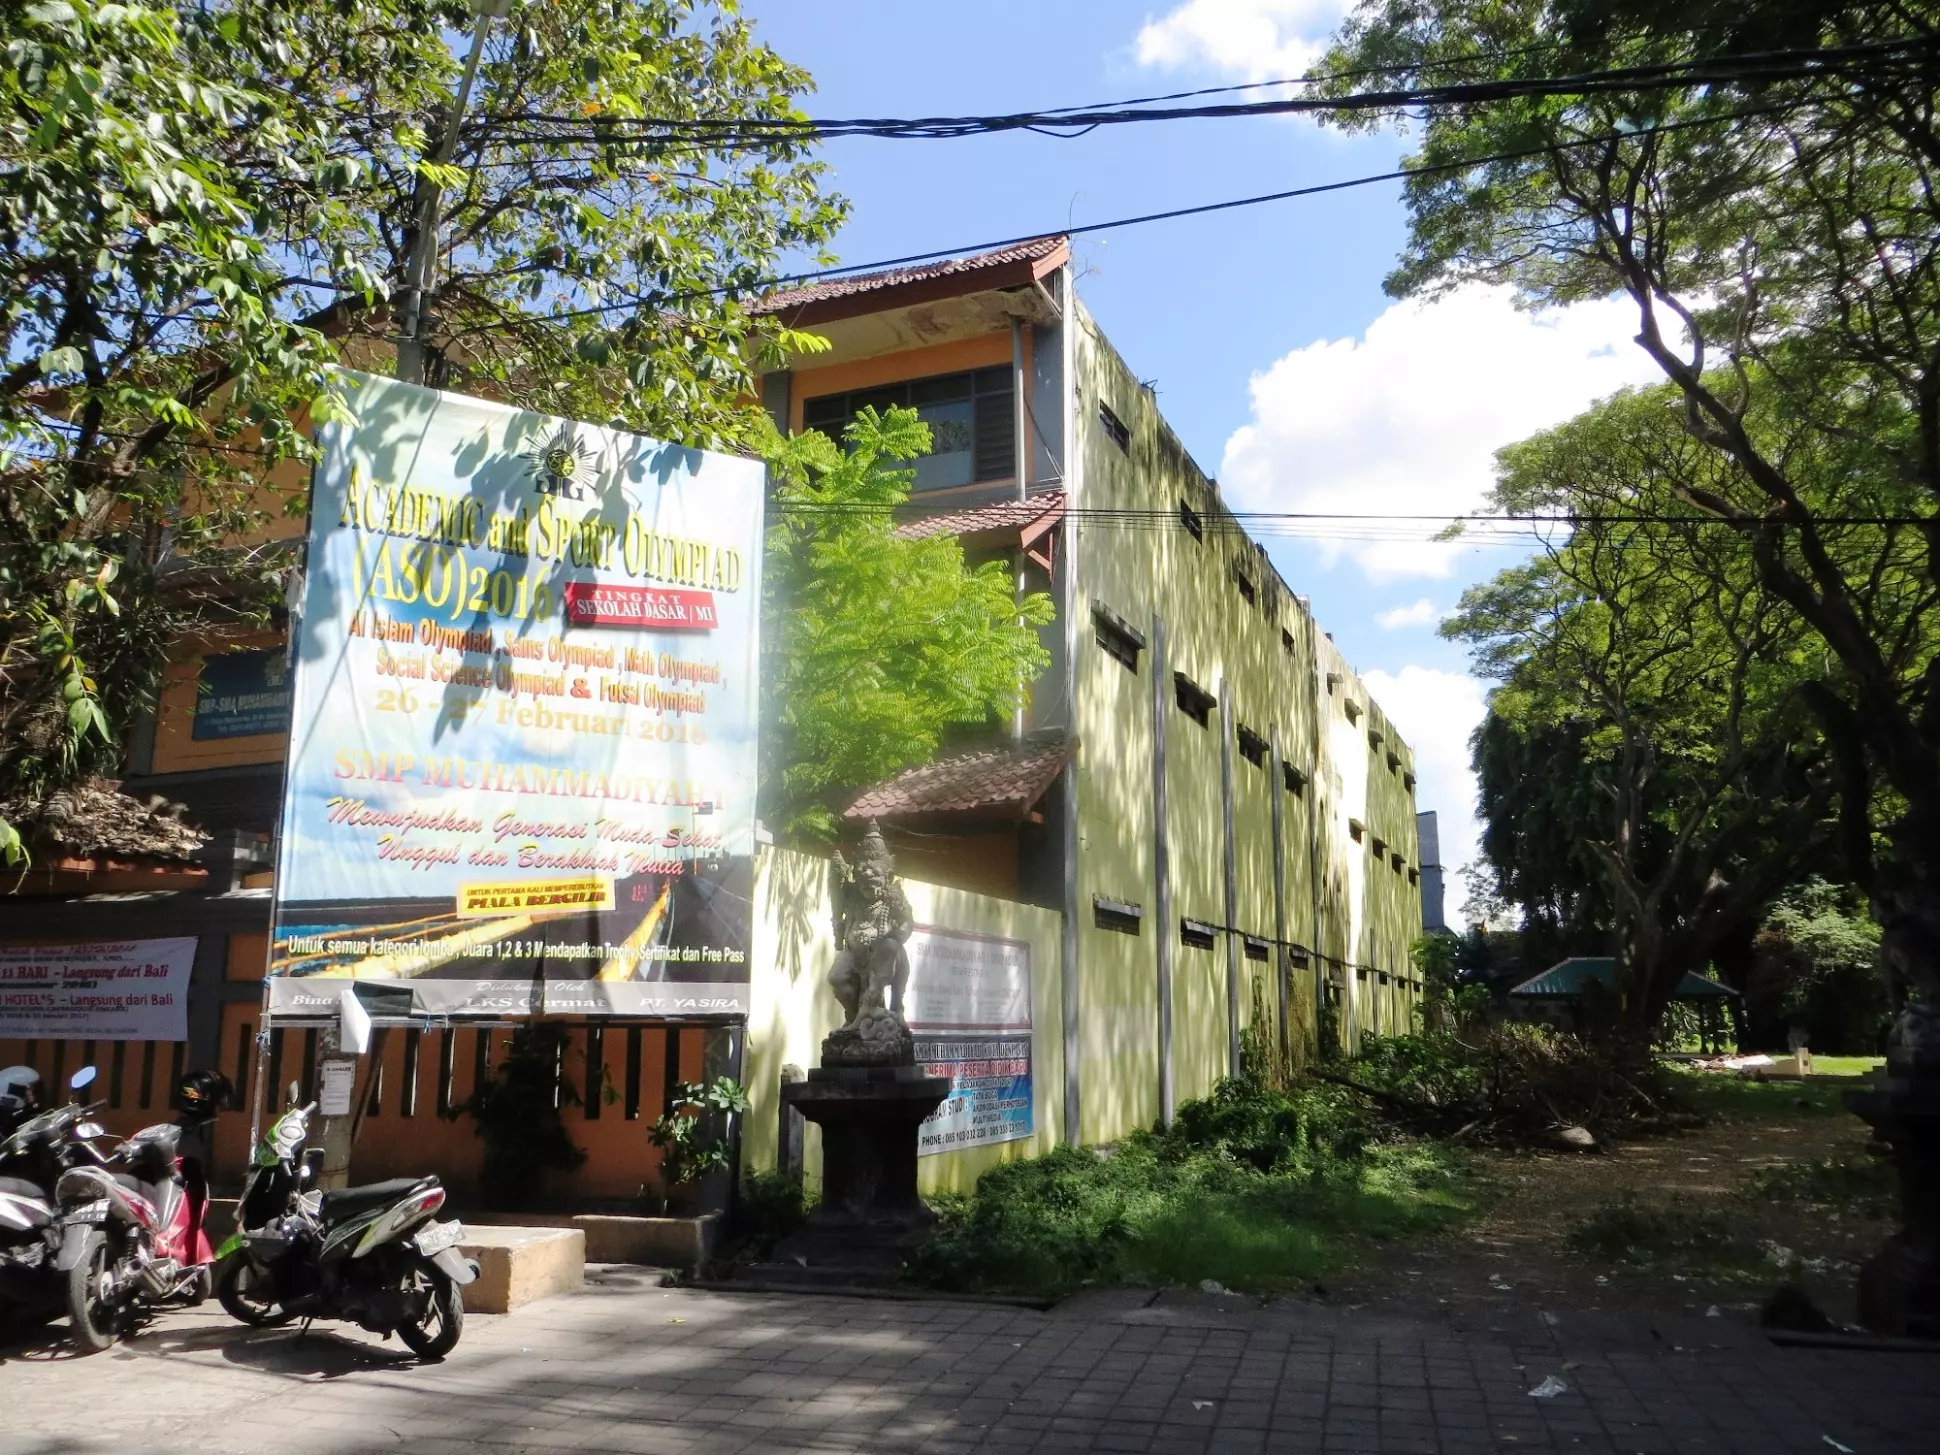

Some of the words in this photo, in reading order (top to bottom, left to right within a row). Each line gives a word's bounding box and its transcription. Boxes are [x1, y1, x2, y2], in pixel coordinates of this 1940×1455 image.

[338, 464, 486, 550] ACADEMIC
[488, 505, 533, 557] and
[536, 495, 616, 571] SPORT
[624, 512, 743, 593] OLYMPIAD
[592, 589, 682, 605] TINGKAT
[577, 599, 641, 617] SEKOLAH
[645, 602, 687, 620] DASAR
[696, 606, 714, 621] MI
[370, 612, 415, 643] Islam
[504, 629, 543, 660] Sains
[624, 647, 656, 675] Math
[376, 647, 426, 680] Social
[431, 654, 492, 688] Science
[496, 663, 566, 701] Olympiad
[570, 678, 592, 699] &
[599, 676, 641, 706] Futsal
[644, 683, 706, 718] Olympiad
[375, 687, 420, 714] 26
[495, 698, 631, 737] Februari
[334, 748, 415, 783] SMP
[422, 755, 706, 808] MUHAMMADIYAH
[326, 796, 484, 836] Mewujudkan
[493, 807, 588, 843] Generasi
[594, 818, 655, 845] Muda
[661, 826, 726, 849] Sehat
[377, 832, 460, 871] Unggul
[468, 844, 508, 867] dan
[517, 841, 619, 871] Berakhlak
[467, 888, 491, 896] UNTUK
[493, 887, 525, 895] PERTAMA
[545, 883, 604, 893] MEMPEREBUTKAN
[467, 896, 521, 908] PIALA
[526, 892, 606, 906] BERGILIR
[288, 934, 324, 954] Untuk
[327, 940, 368, 955] semua
[370, 937, 417, 959] kategori
[463, 940, 493, 957] Juara
[515, 942, 523, 957] &
[526, 941, 532, 957] 3
[639, 943, 680, 960] Sertifikat
[682, 946, 700, 961] dan
[702, 946, 722, 962] Free
[724, 946, 744, 963] Pass
[17, 966, 48, 979] HARI
[62, 966, 115, 981] Langsung
[118, 965, 141, 978] dari
[144, 964, 169, 977] Bali
[70, 994, 122, 1009] Langsung
[126, 994, 148, 1005] dari
[152, 994, 173, 1005] Bali
[292, 995, 333, 1005] Bina
[464, 997, 513, 1007] LKS
[673, 998, 740, 1008] YASIRA
[959, 1061, 990, 1078] PESERTA
[922, 1134, 941, 1147] PHONE
